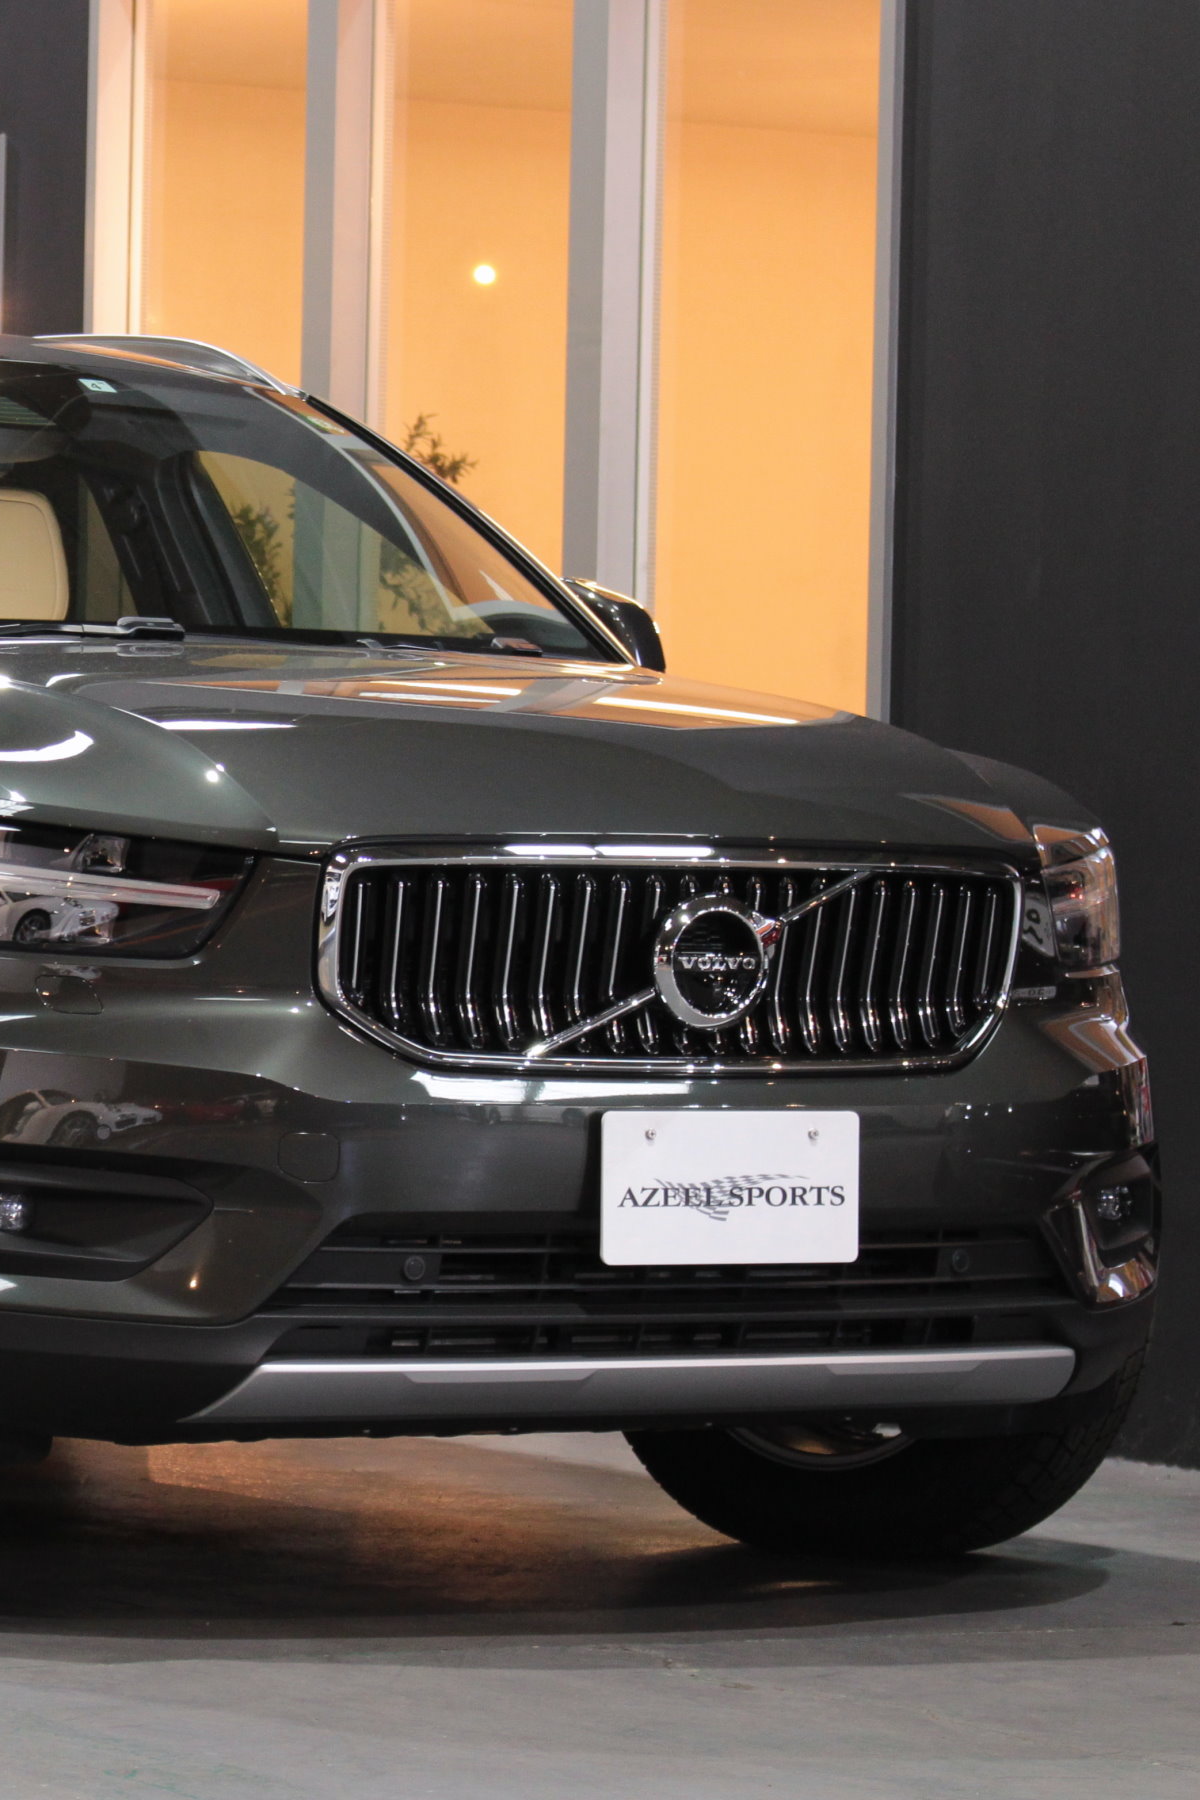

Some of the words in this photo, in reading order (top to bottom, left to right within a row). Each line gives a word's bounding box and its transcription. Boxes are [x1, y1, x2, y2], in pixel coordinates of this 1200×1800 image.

[678, 956, 756, 970] VOLVO
[617, 1187, 723, 1208] AZEEL
[727, 1186, 846, 1208] SPORTS
